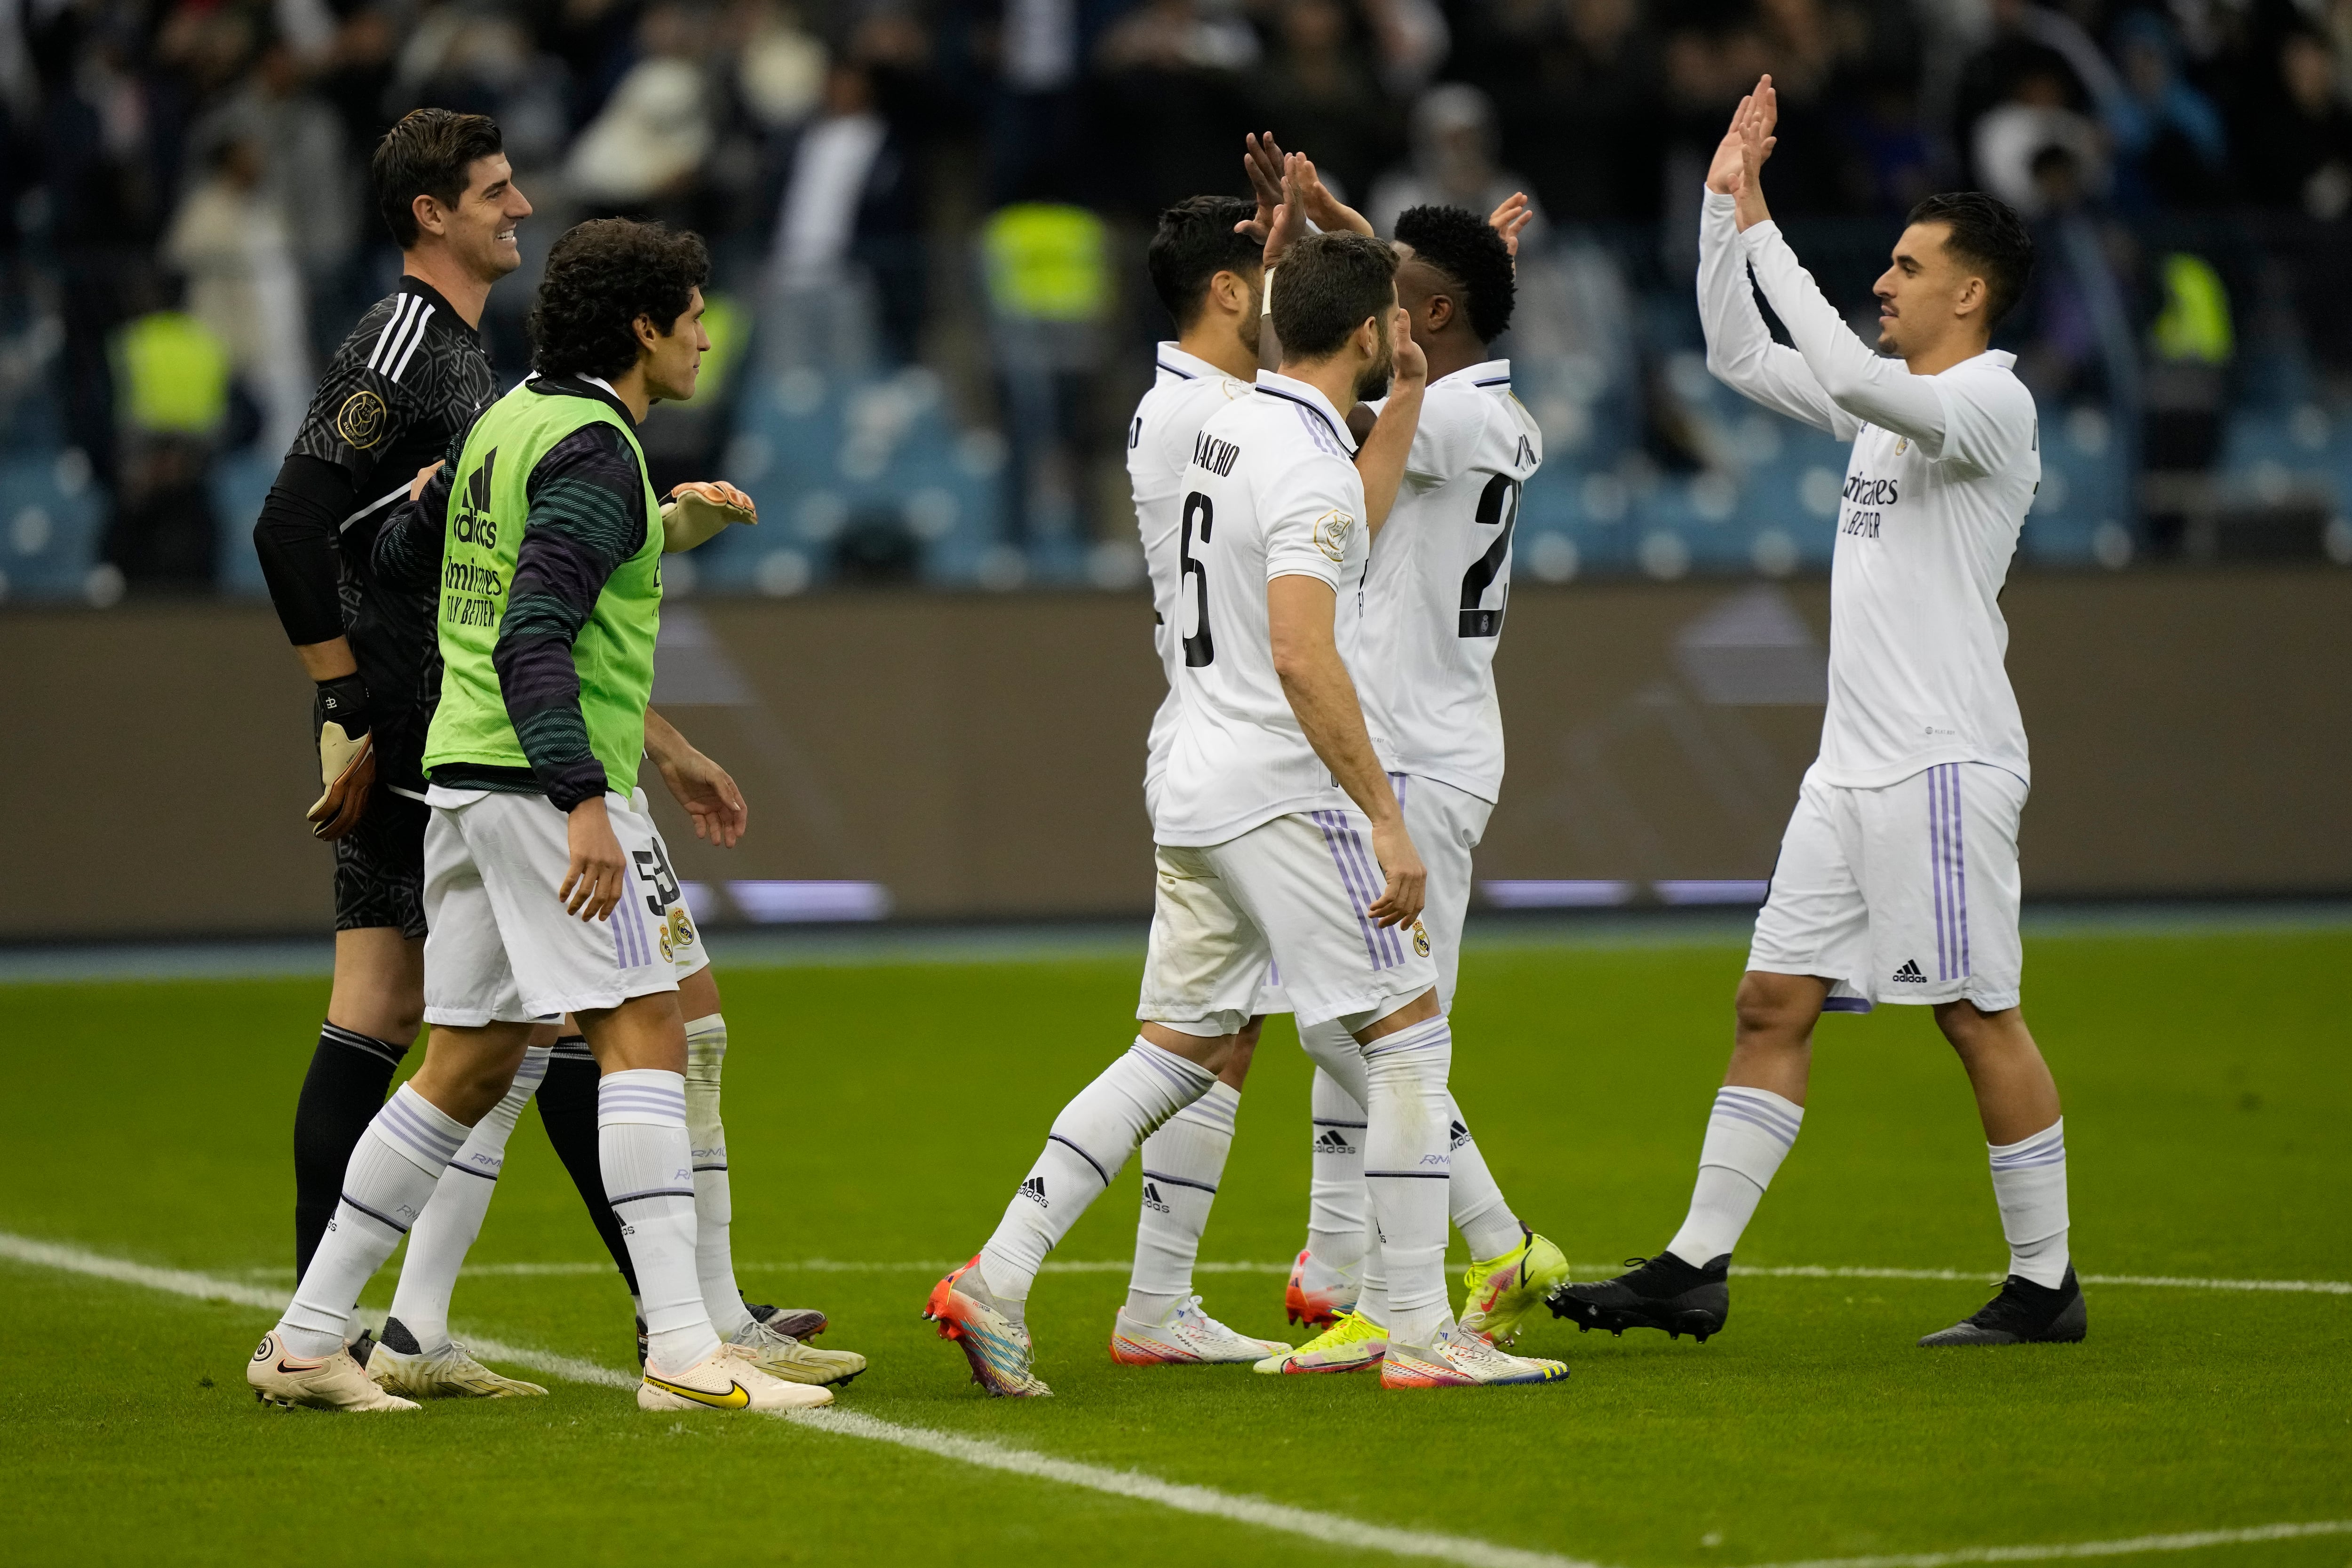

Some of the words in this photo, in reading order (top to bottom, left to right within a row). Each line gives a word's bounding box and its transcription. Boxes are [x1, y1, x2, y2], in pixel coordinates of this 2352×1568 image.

[1192, 430, 1240, 478] NACHO
[1458, 472, 1523, 638] 2
[1180, 491, 1214, 668] 6
[460, 598, 495, 627] BETTER
[1892, 973, 1928, 983] adidas
[972, 1300, 991, 1313] PREDATOR
[647, 1379, 671, 1392] TIEMPO
[647, 1389, 661, 1397] VALLEJO
